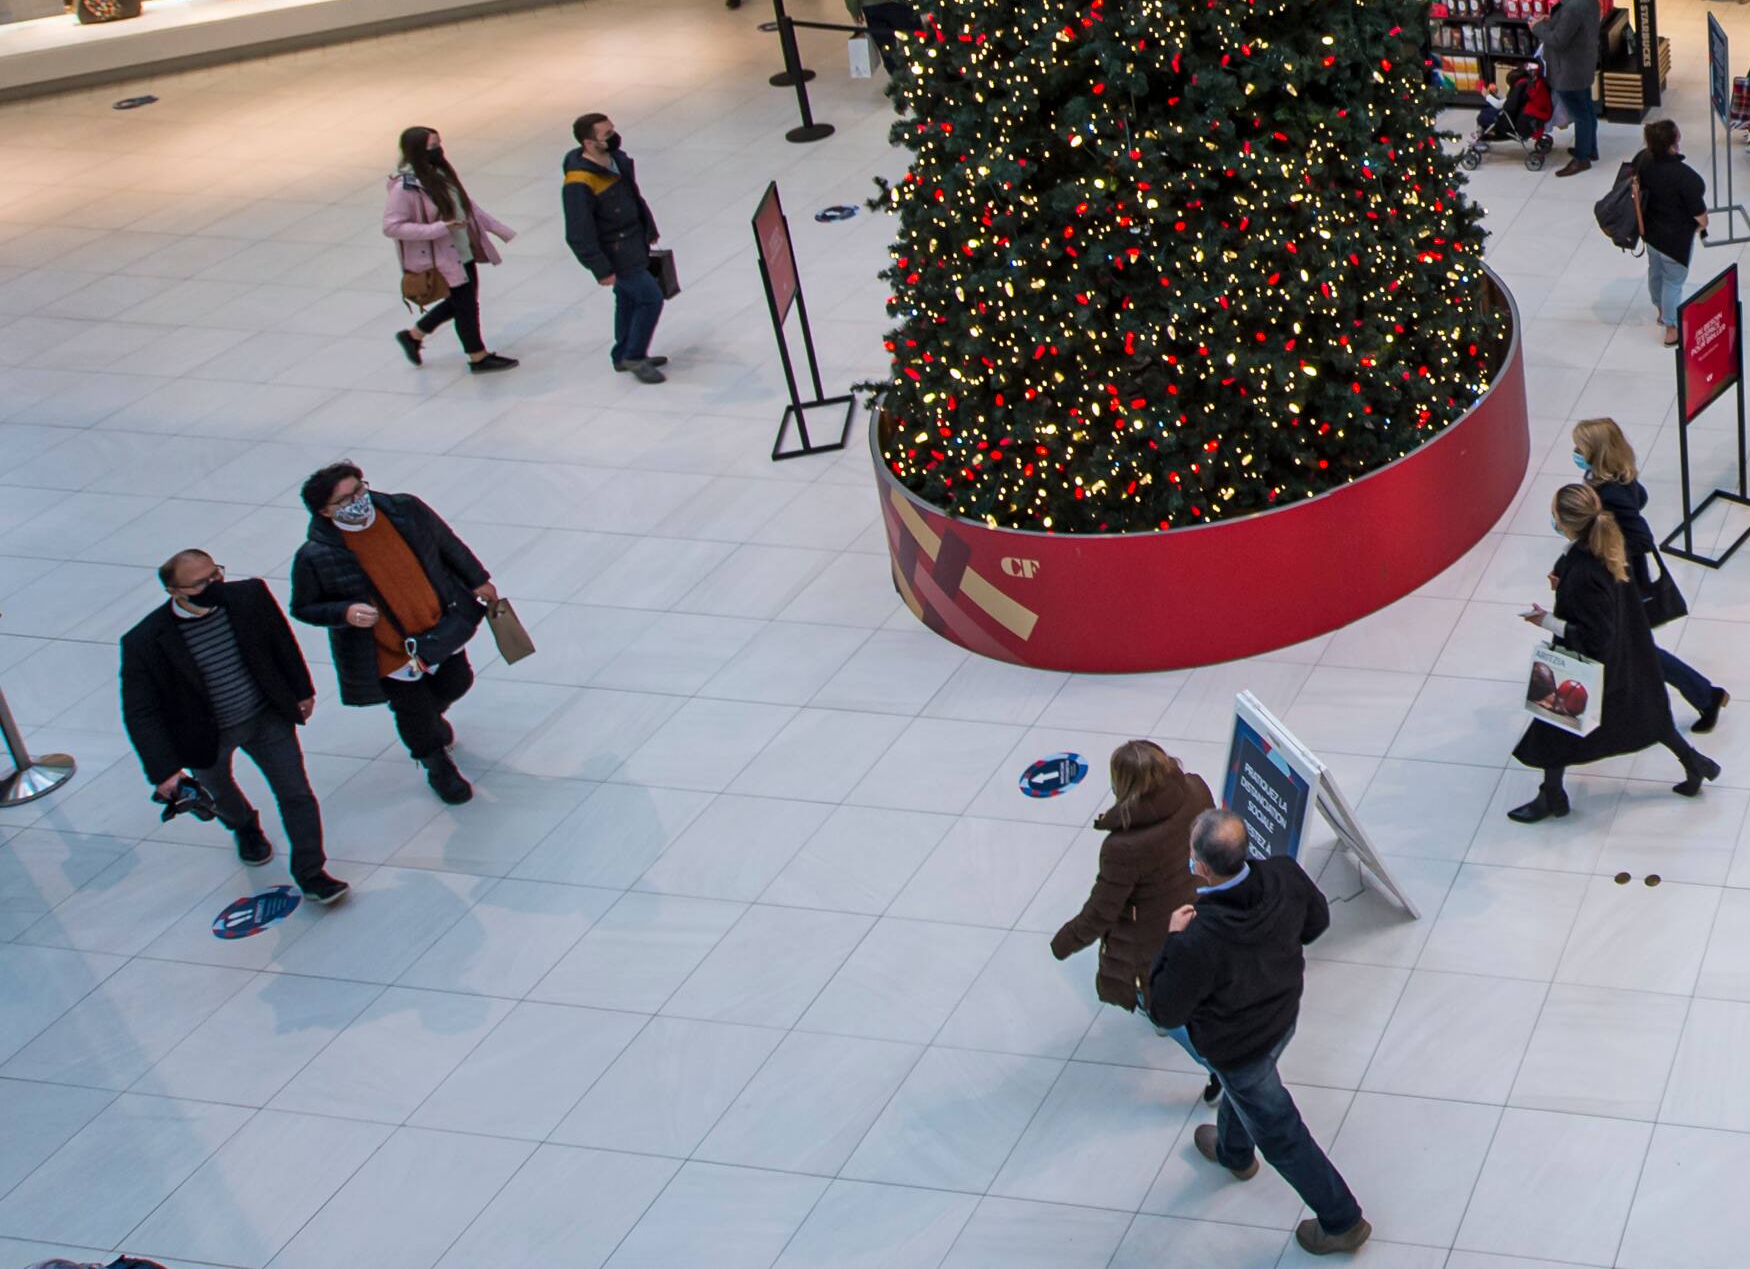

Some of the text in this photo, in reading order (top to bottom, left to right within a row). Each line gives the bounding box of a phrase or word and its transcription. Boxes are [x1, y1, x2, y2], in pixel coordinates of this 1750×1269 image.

[1639, 5, 1652, 68] STARBUCKS
[1001, 556, 1041, 579] CF
[1240, 775, 1287, 829] DISTANCIATION
[1244, 761, 1288, 813] PRATIQUEZ LA
[1247, 800, 1275, 834] SOCIALE
